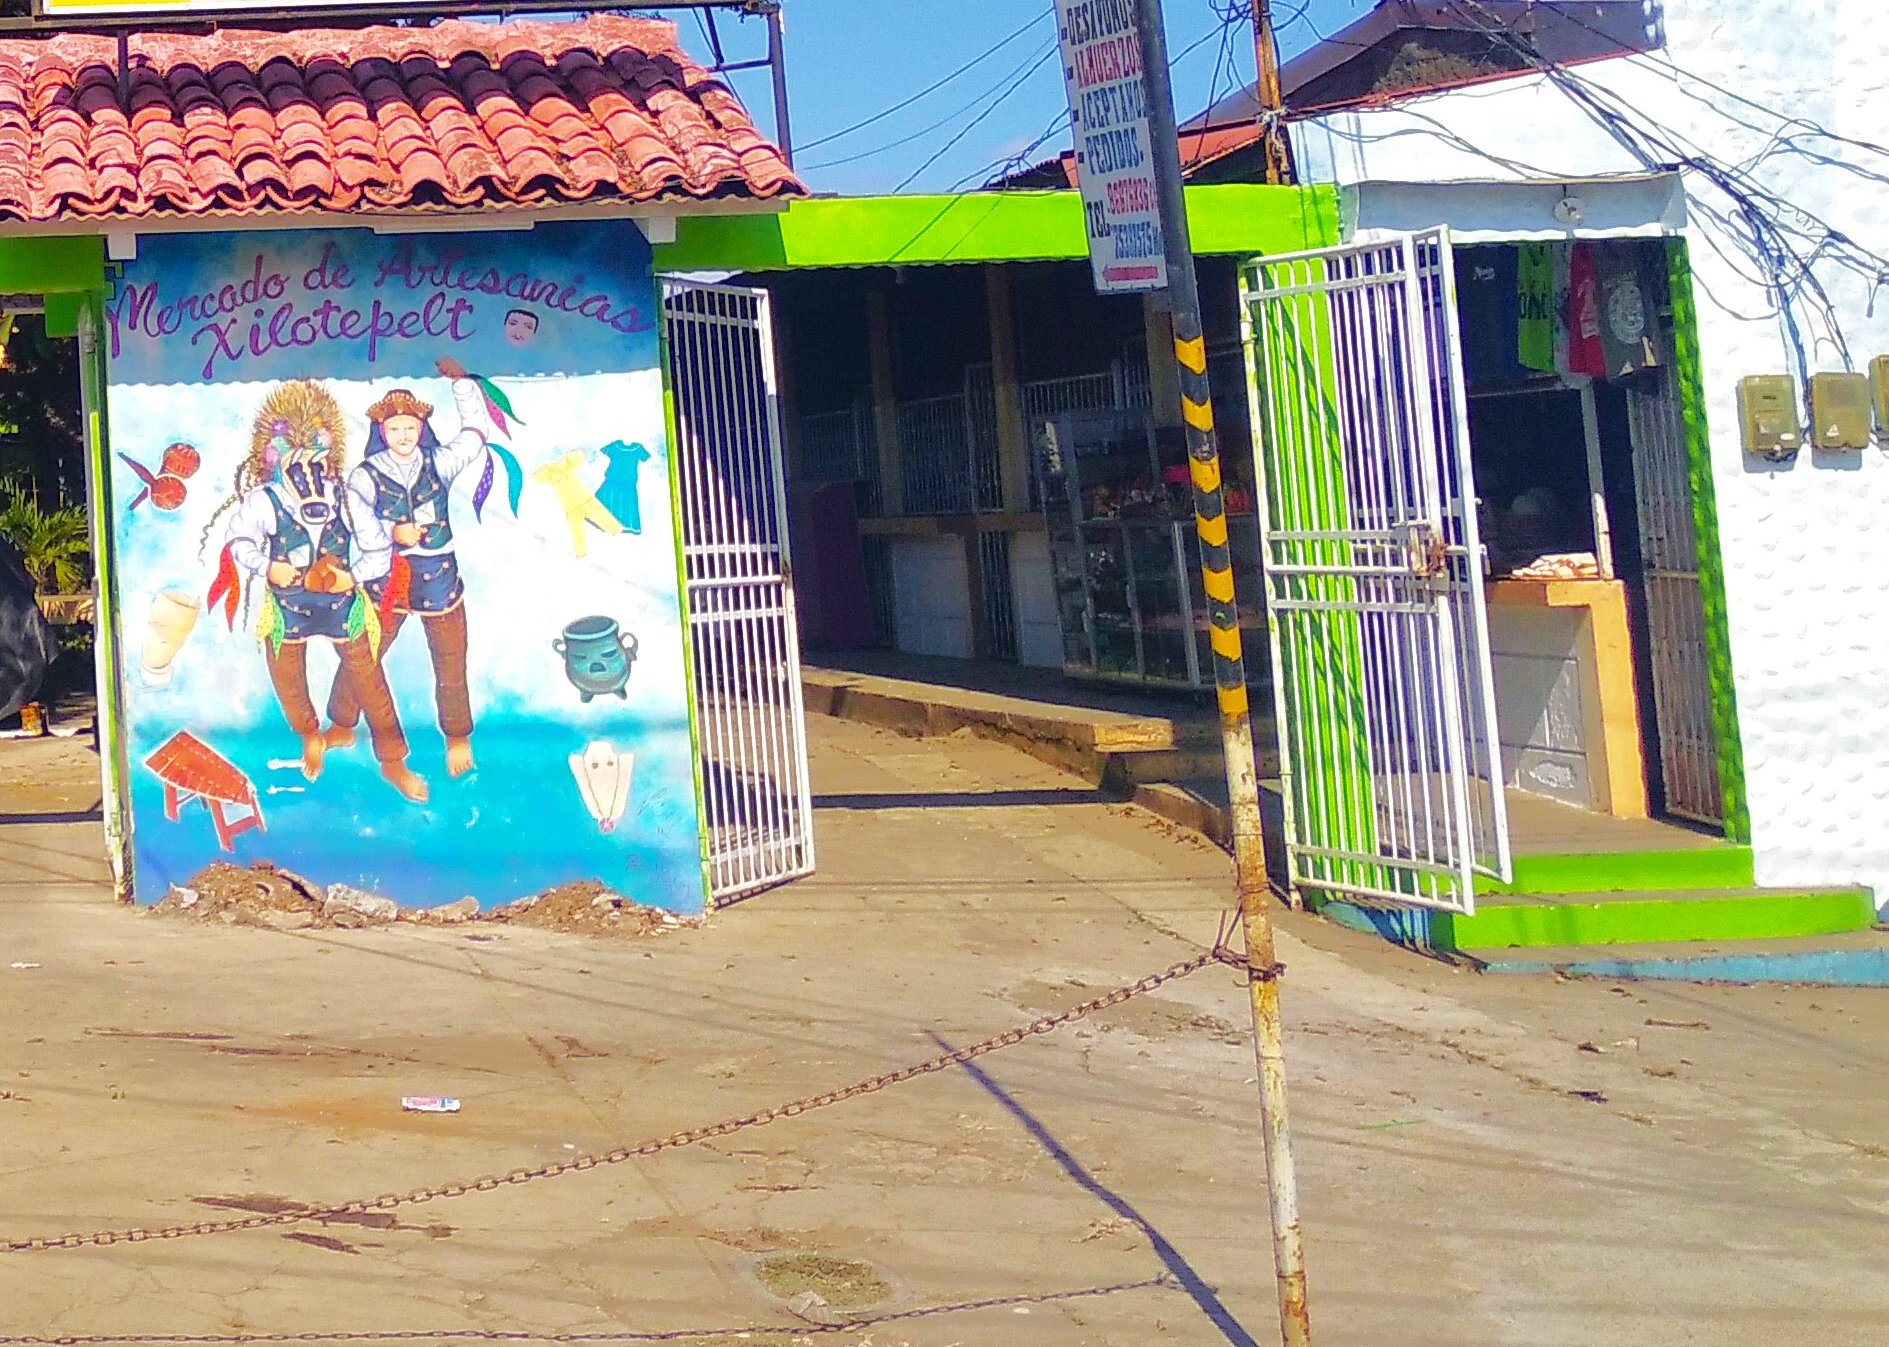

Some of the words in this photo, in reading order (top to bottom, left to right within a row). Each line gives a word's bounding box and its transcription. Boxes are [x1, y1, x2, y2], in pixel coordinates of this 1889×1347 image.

[1075, 32, 1143, 88] ALMUERZOS
[104, 254, 287, 359] Mercado
[302, 241, 355, 290] de
[373, 243, 652, 334] Artesanias
[191, 290, 475, 380] Xilotepelt
